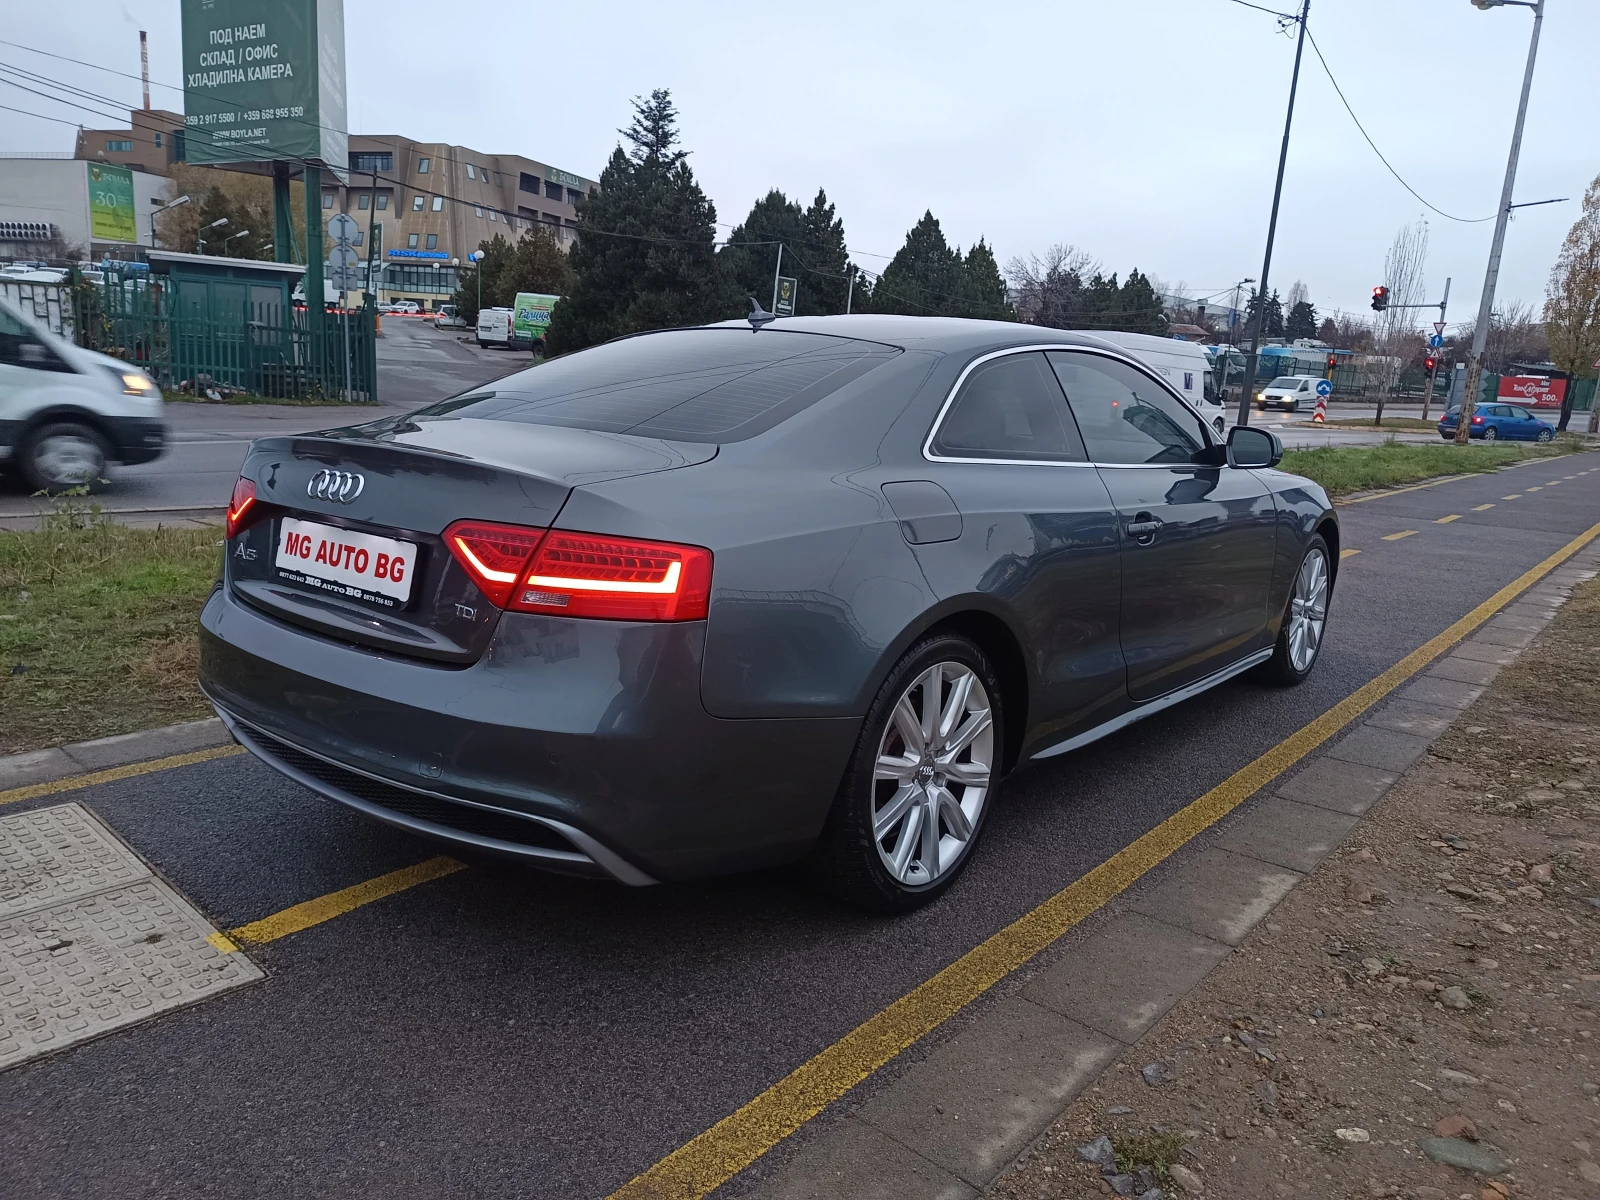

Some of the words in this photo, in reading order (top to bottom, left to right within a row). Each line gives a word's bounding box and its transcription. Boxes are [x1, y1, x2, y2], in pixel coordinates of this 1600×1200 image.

[210, 28, 232, 45] ПОД
[234, 24, 266, 42] НАЕМ
[200, 50, 236, 66] СКЛАД
[238, 48, 242, 64] /
[246, 44, 278, 61] ОФИС
[188, 68, 245, 88] ХЛАДИЛНА
[248, 63, 293, 81] КАМЕРА
[199, 115, 204, 124] 2
[205, 114, 217, 124] 917
[218, 112, 234, 122] 5500
[237, 112, 241, 122] /
[244, 110, 260, 120] +359
[275, 108, 289, 118] 955
[290, 106, 304, 117] 350
[96, 191, 116, 208] 30
[518, 308, 551, 325] Ралица
[234, 542, 257, 561] A5
[284, 532, 312, 560] MG
[315, 540, 369, 574] AUTO
[374, 553, 405, 582] BG
[305, 576, 322, 587] MG
[345, 587, 362, 598] BG
[455, 603, 477, 621] TDI
